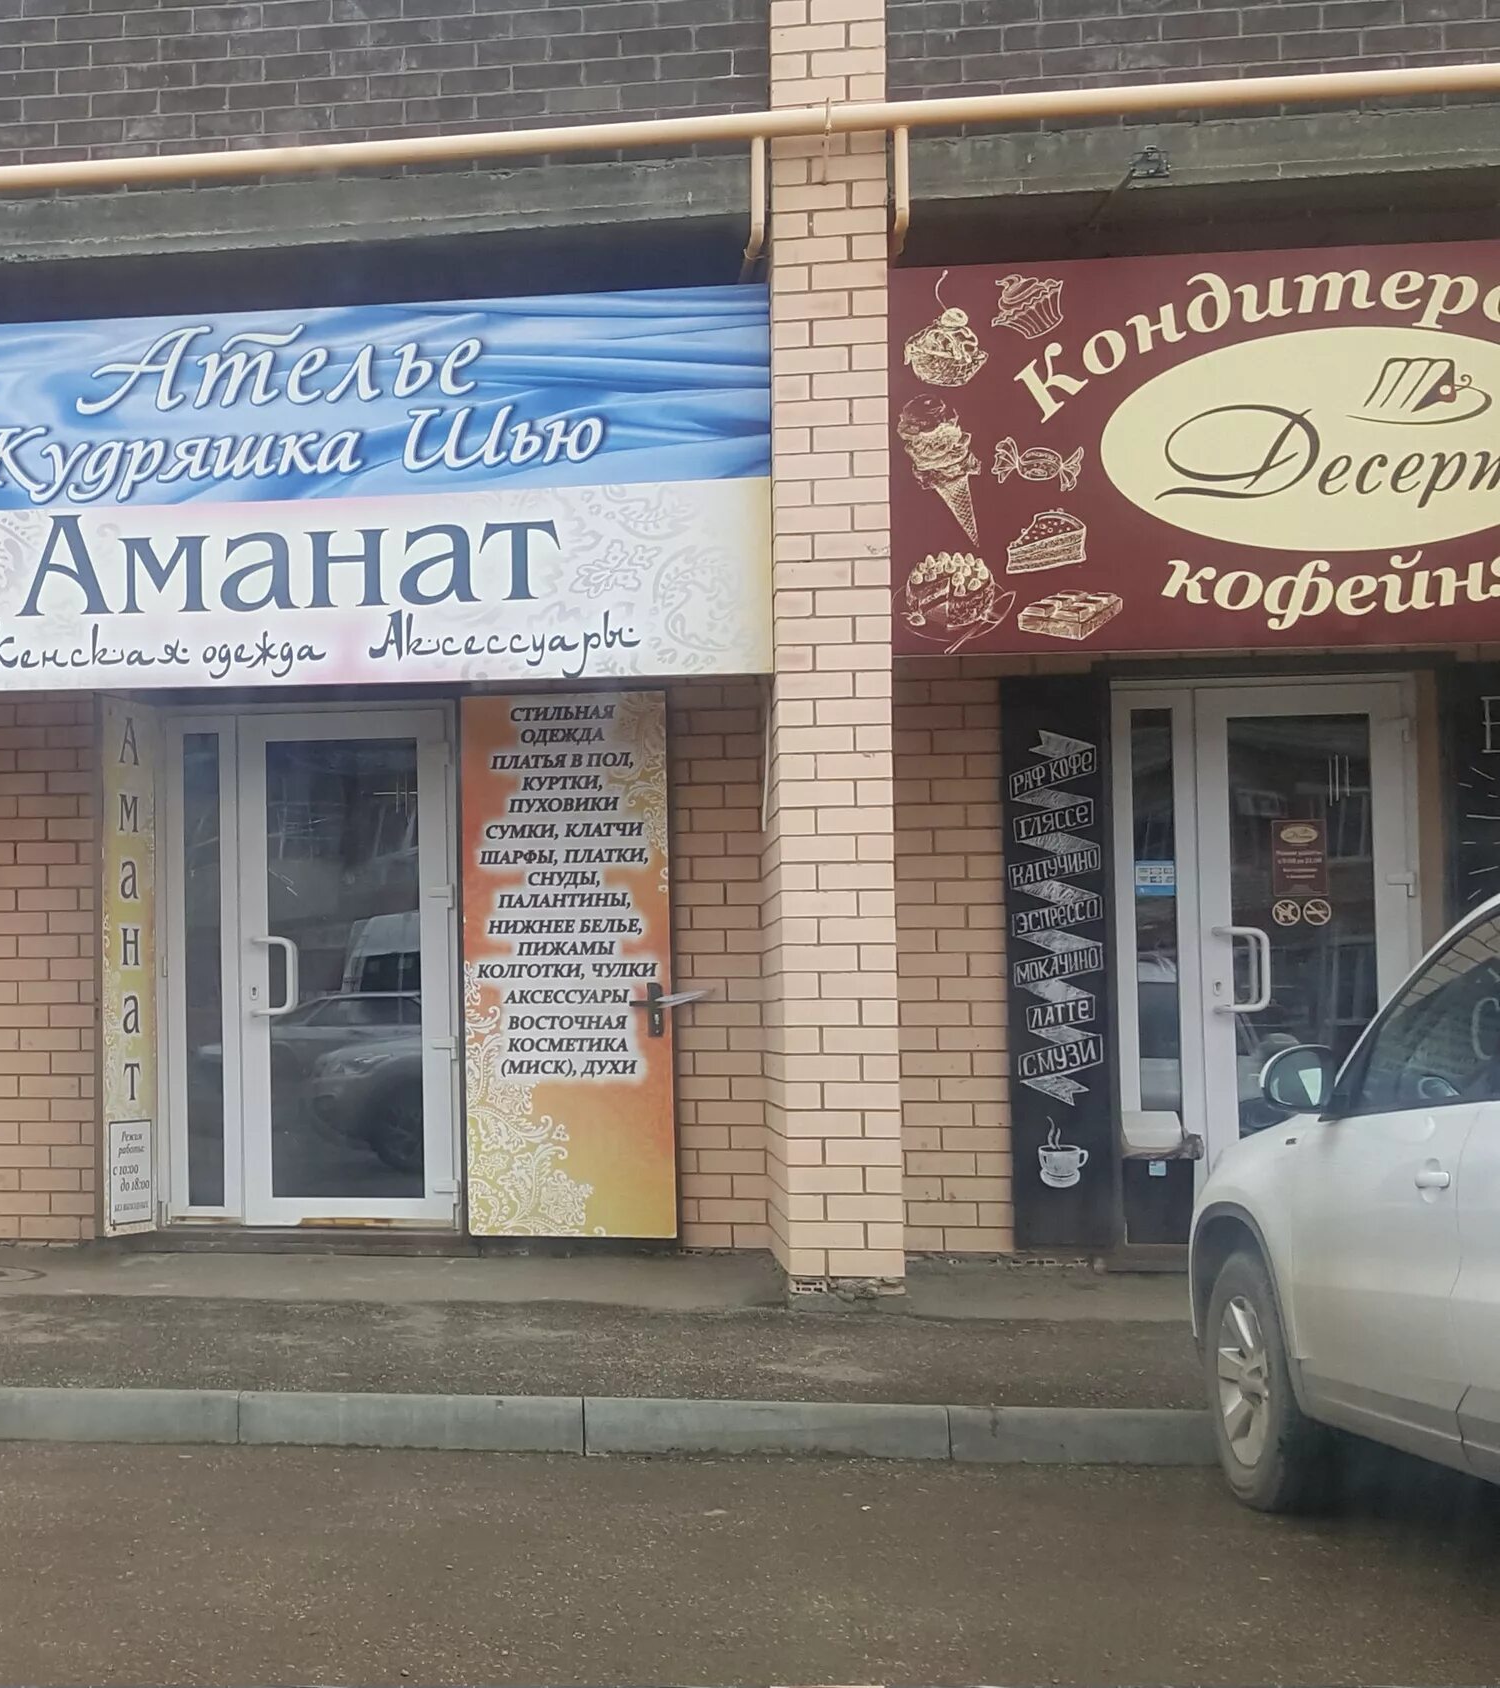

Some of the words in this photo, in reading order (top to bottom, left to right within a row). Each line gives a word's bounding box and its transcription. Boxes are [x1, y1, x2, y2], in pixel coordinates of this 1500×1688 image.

[75, 320, 483, 417] Ателье
[402, 405, 606, 473] Шью
[199, 634, 328, 679] одежда
[366, 610, 643, 679] Аксессуары
[510, 704, 616, 722] СТИЛЬНАЯ
[520, 727, 605, 747] ОДЕЖДА
[489, 753, 568, 770] ПЛАТЬЯ
[570, 753, 583, 769] В
[587, 751, 635, 769] ПОЛ,
[521, 775, 603, 792] КУРТКИ,
[1013, 766, 1047, 795] РАФ
[508, 796, 620, 813] ПУХОВИКИ
[485, 822, 560, 841] СУМКИ,
[564, 821, 644, 838] КЛАТЧИ
[478, 849, 559, 867] ШАРФЫ,
[563, 848, 649, 865] ПЛАТКИ,
[1011, 849, 1098, 887] КАПУЧИНО
[527, 871, 601, 889] СНУДЫ,
[497, 892, 632, 910] ПАЛАНТИНЫ,
[487, 919, 576, 935] НИЖНЕЕ
[579, 918, 643, 935] БЕЛЬЕ,
[516, 941, 616, 957] ПИЖАМЫ
[477, 963, 586, 981] КОЛГОТКИ,
[591, 962, 658, 979] ЧУЛКИ
[1016, 948, 1099, 985] МОКАЧИНО
[503, 989, 630, 1005] АКСЕССУАРЫ
[507, 1015, 628, 1031] ВОСТОЧНАЯ
[507, 1037, 629, 1053] КОСМЕТИКА
[1022, 1039, 1097, 1077] СМУЗИ
[500, 1059, 577, 1077] (МИСК),
[581, 1059, 637, 1078] ДУХИ
